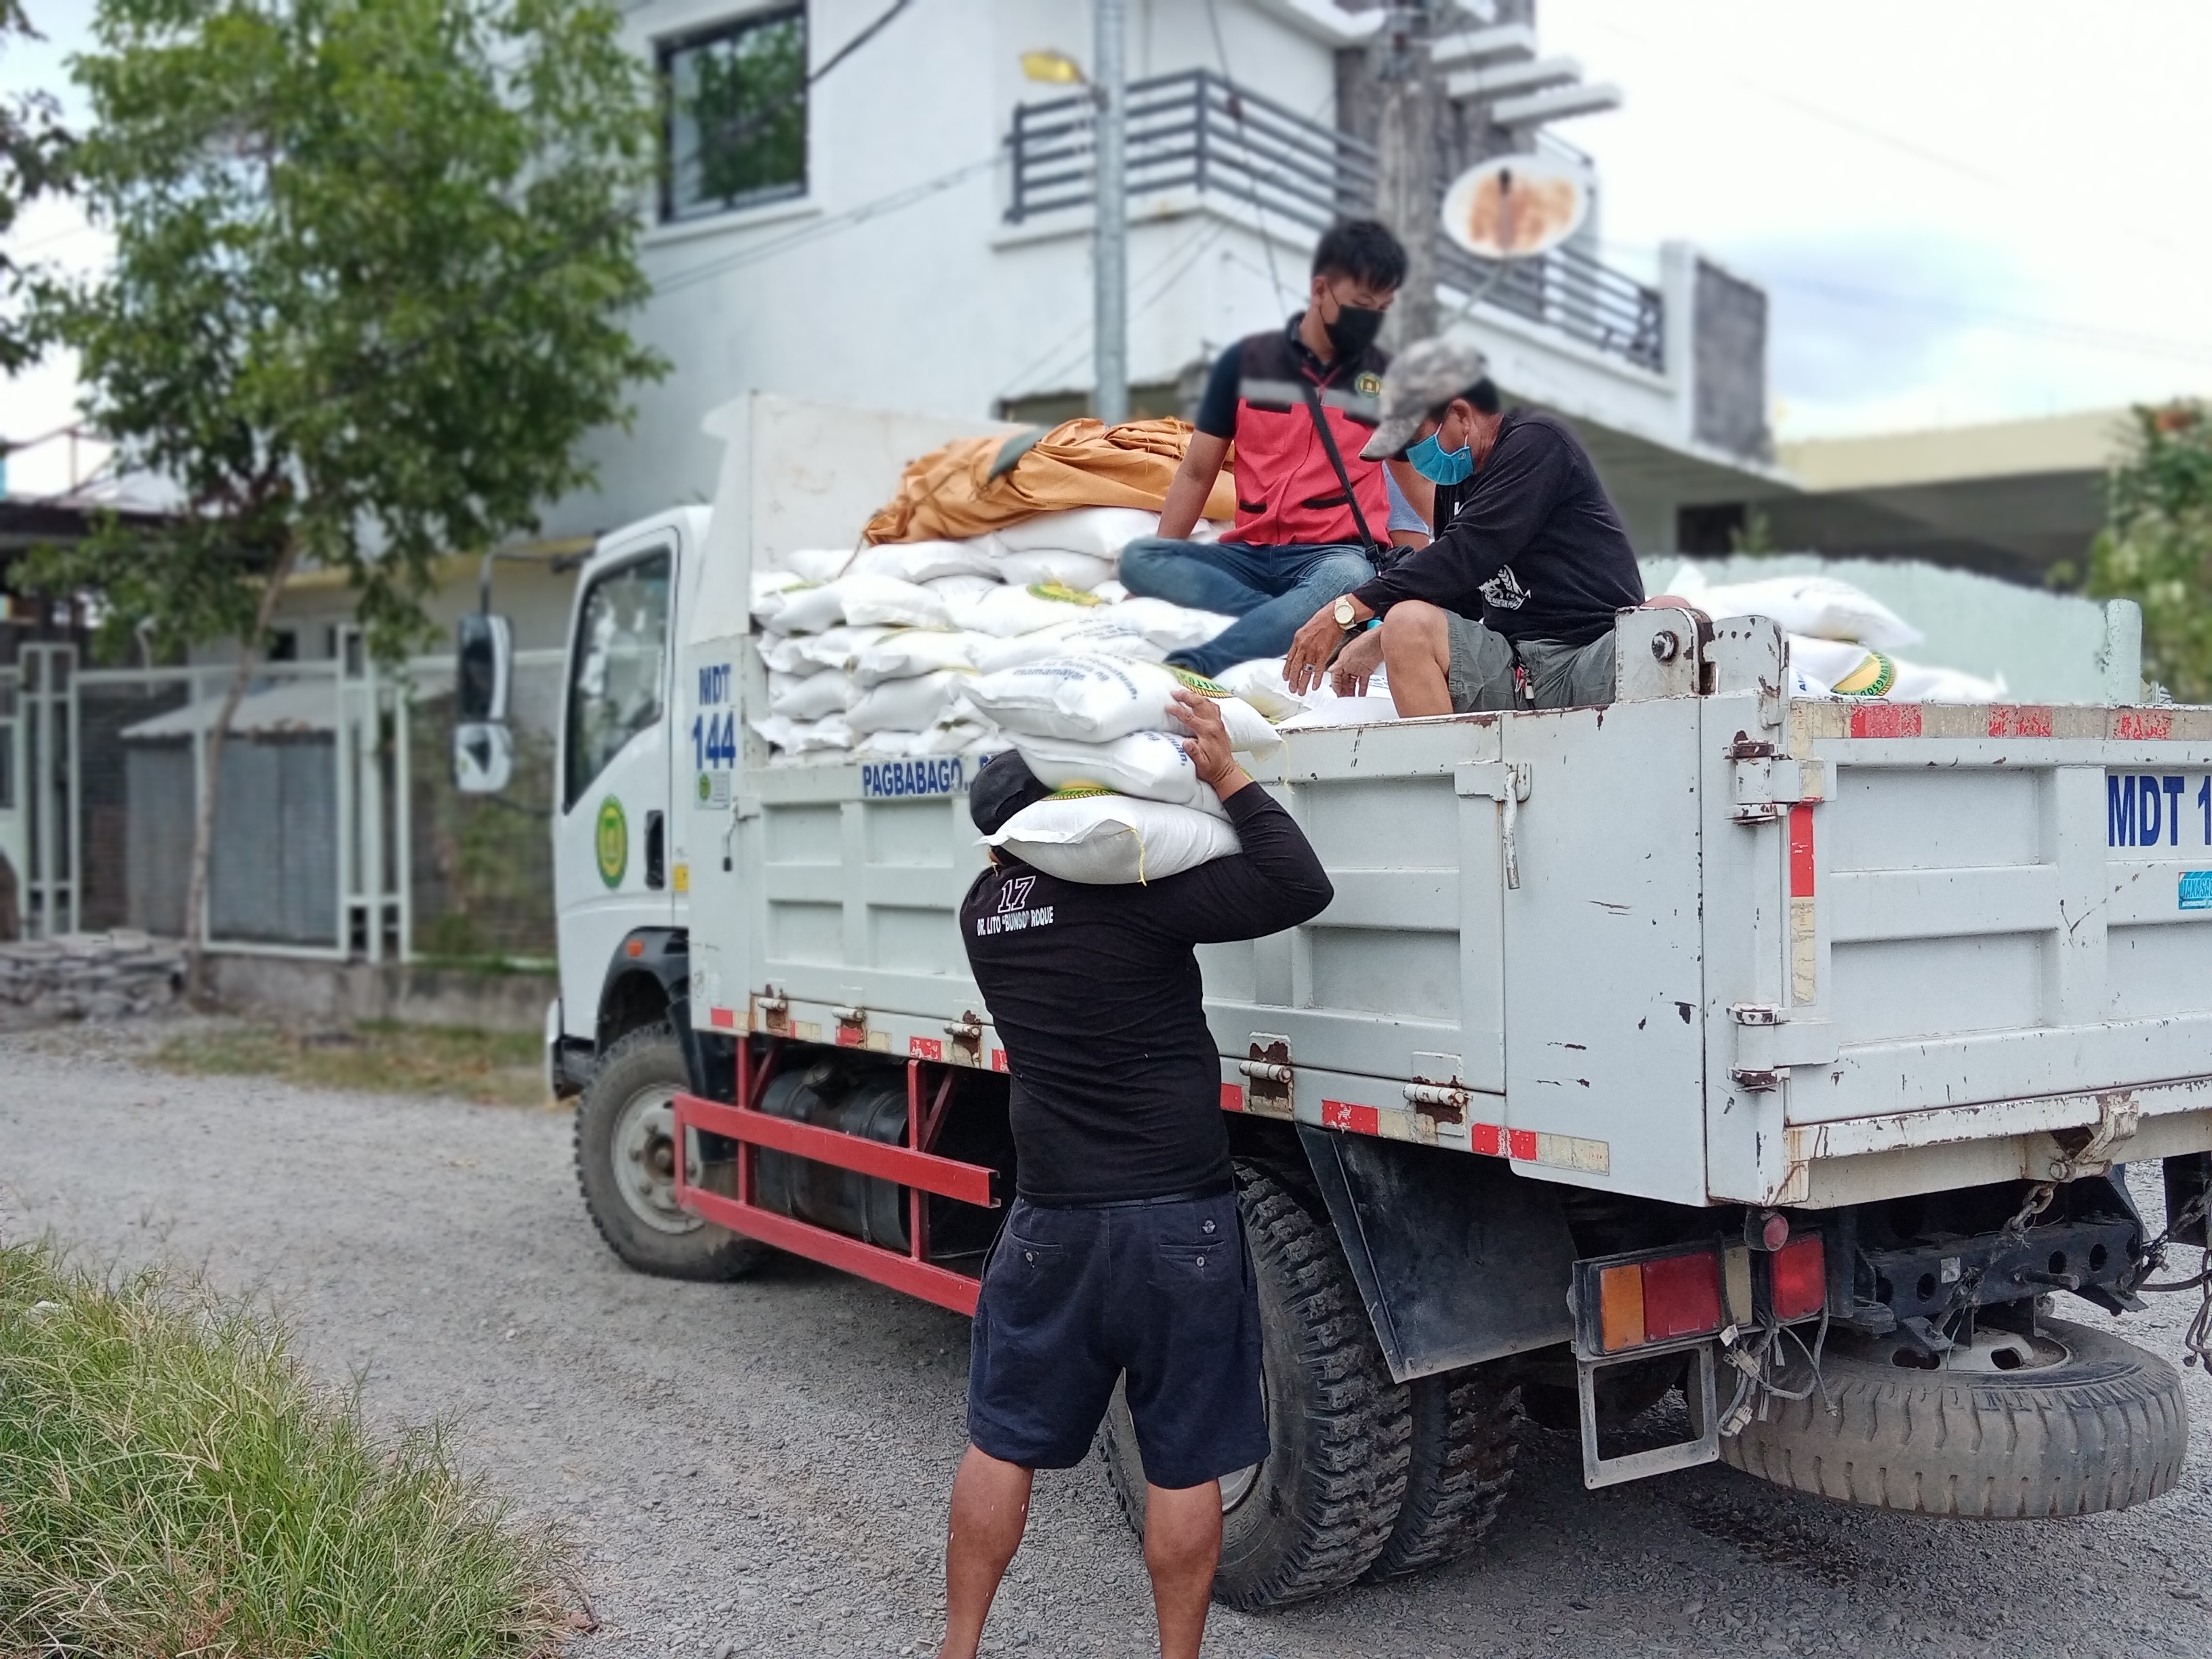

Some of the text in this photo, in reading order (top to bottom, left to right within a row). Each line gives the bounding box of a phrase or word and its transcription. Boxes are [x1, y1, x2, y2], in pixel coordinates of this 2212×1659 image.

[699, 663, 731, 705] MDT
[1012, 668, 1086, 681] mamamayan
[691, 711, 736, 770] 144
[2108, 775, 2185, 846] MDT
[997, 875, 1037, 914] 17
[987, 916, 1002, 935] LITO
[1030, 905, 1054, 928] ROQUE
